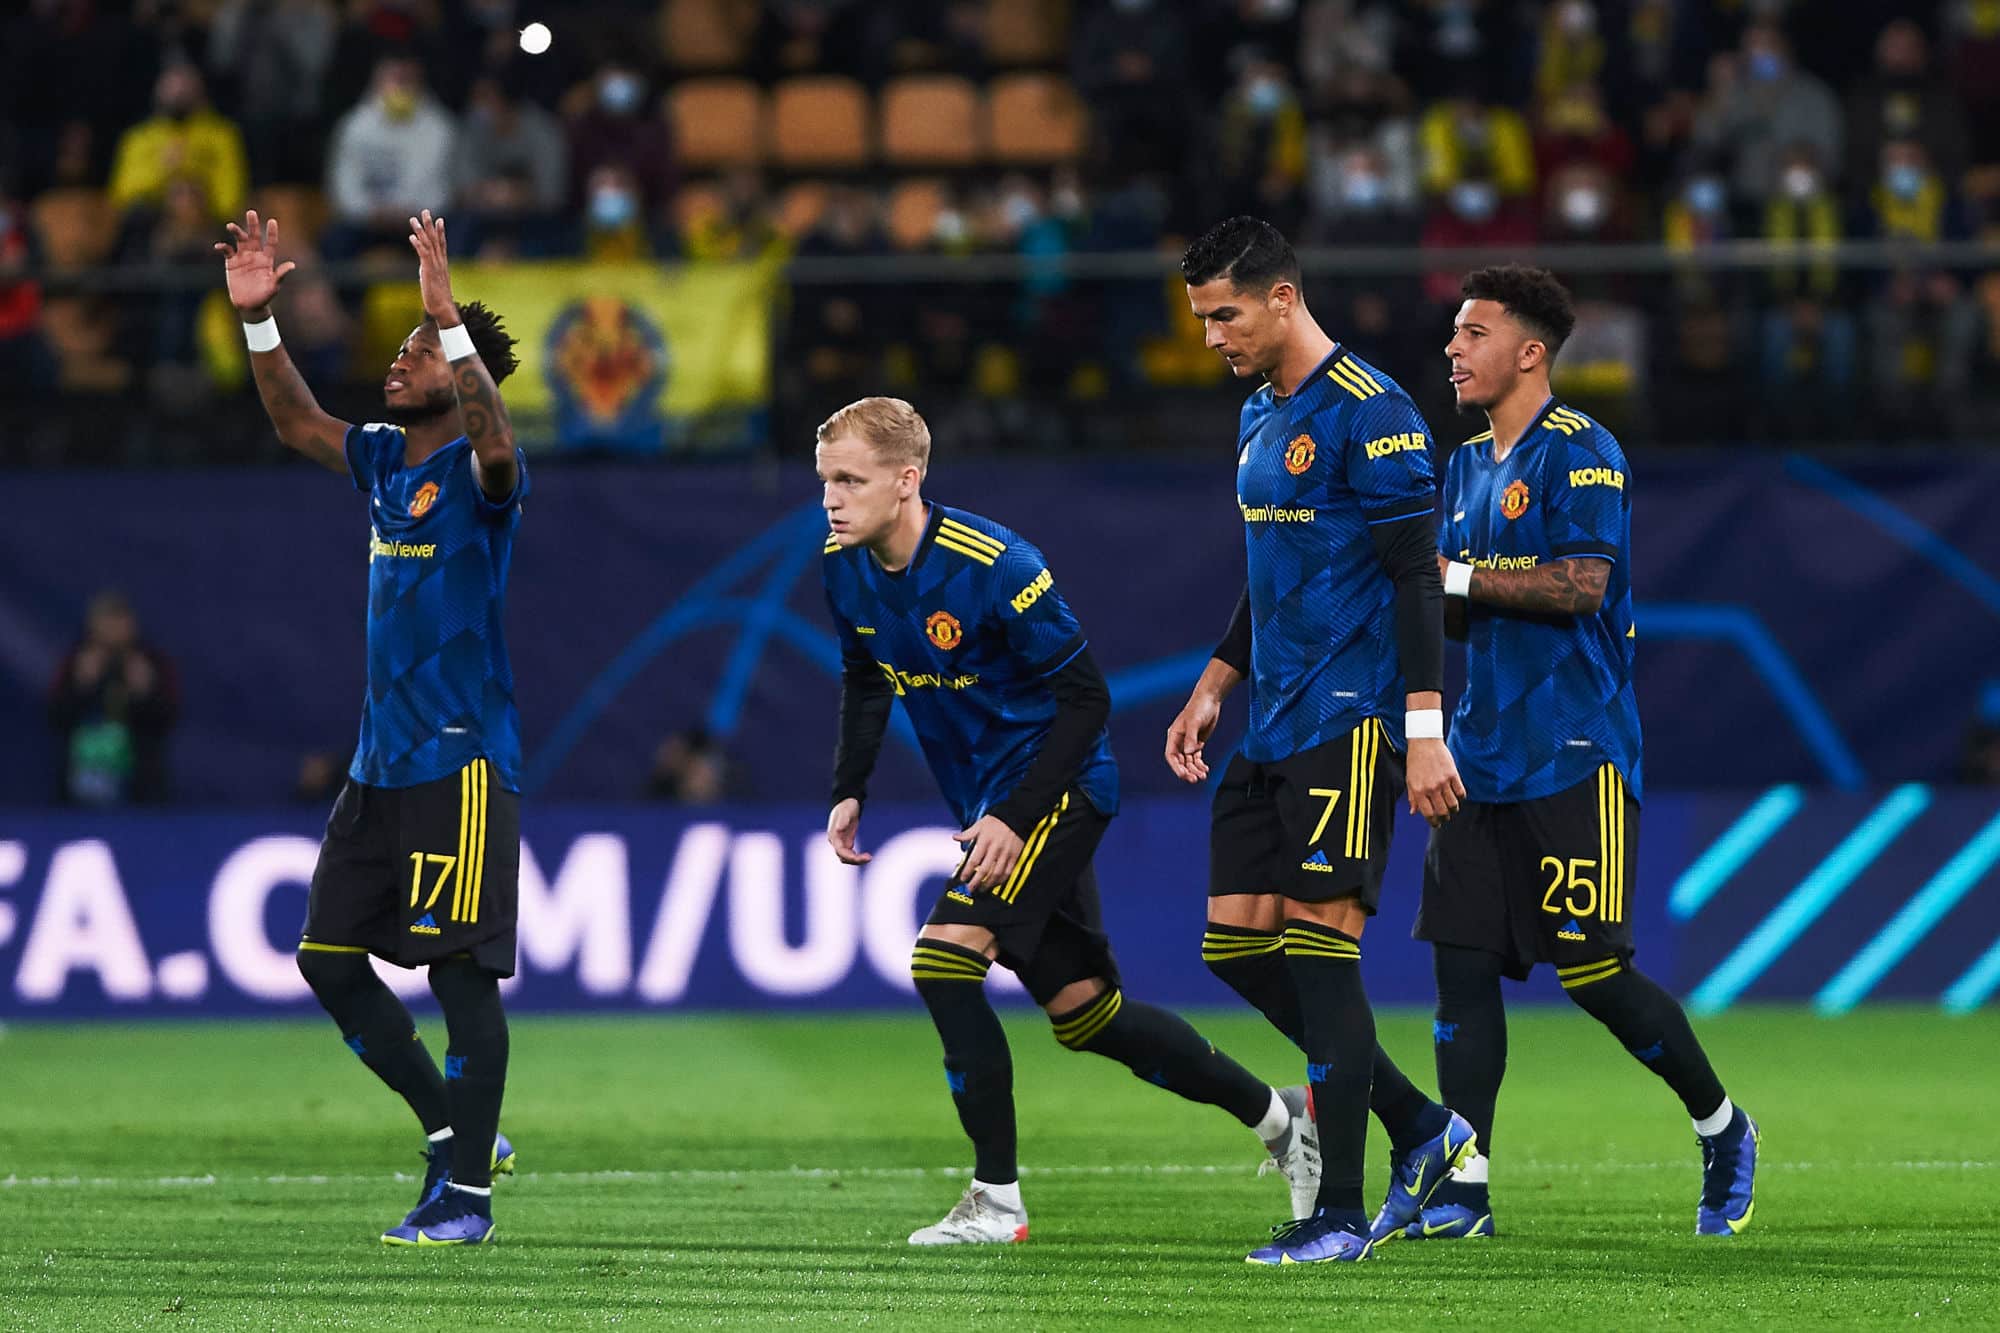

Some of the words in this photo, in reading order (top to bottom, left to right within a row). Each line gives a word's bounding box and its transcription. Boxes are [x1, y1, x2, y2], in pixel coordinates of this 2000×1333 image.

[1242, 504, 1316, 522] TeamViewer
[1309, 788, 1342, 845] 7
[1302, 861, 1333, 873] adidas
[409, 851, 457, 909] 17
[1540, 856, 1597, 917] 25
[410, 924, 441, 935] adidas
[1557, 930, 1586, 941] adidas
